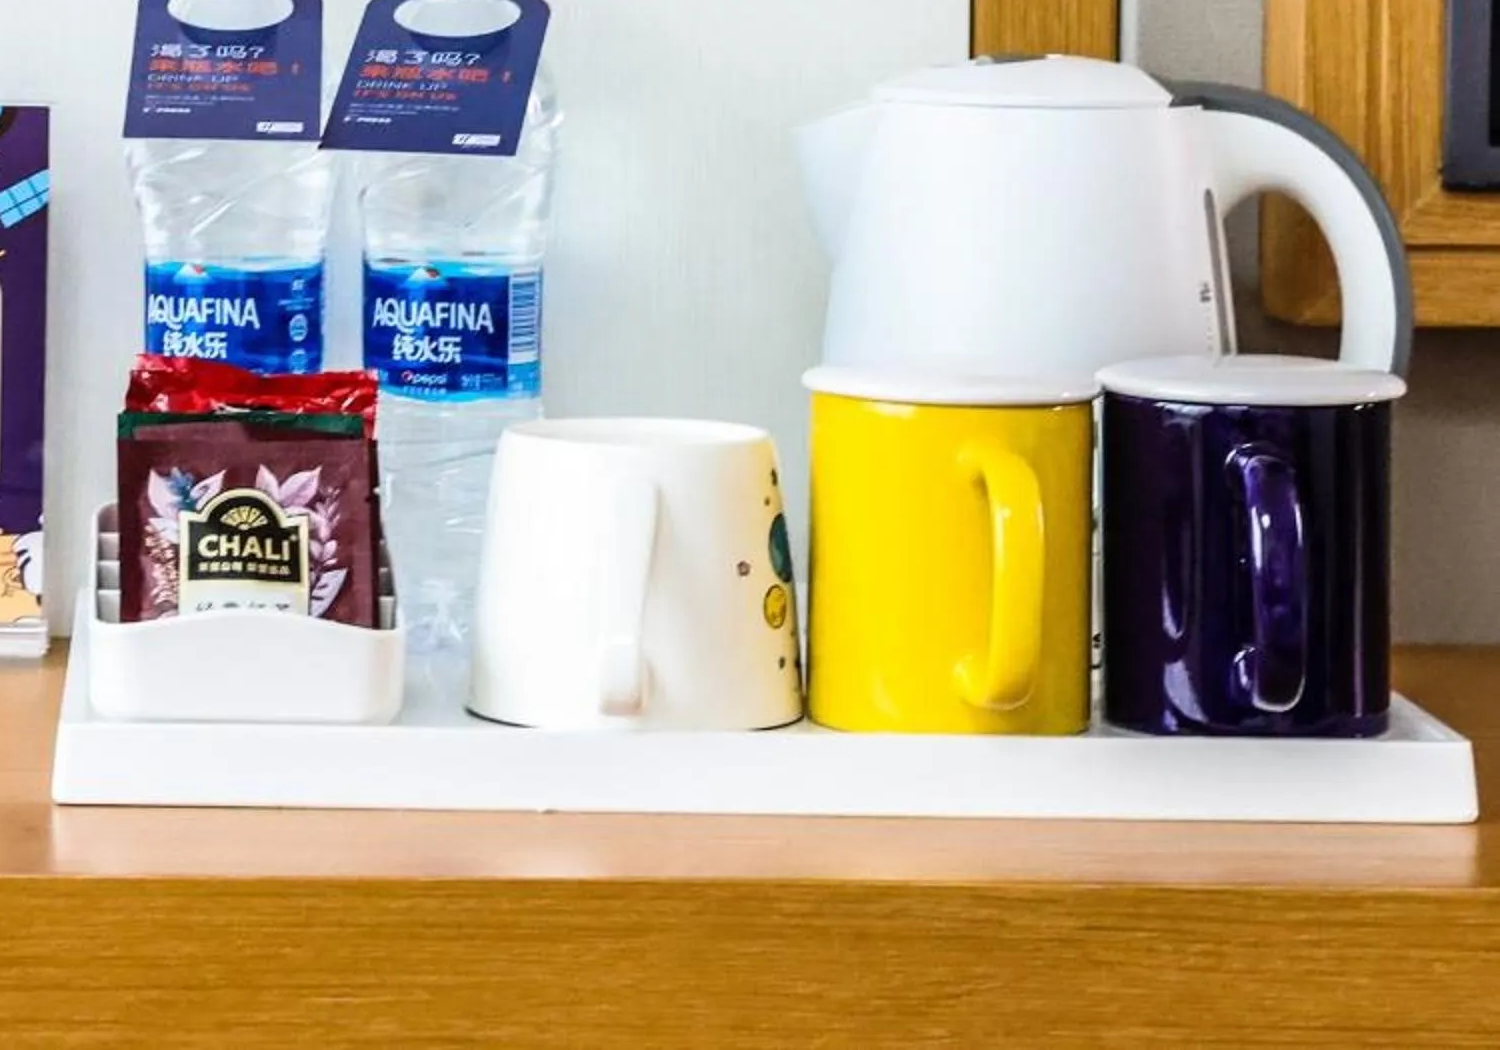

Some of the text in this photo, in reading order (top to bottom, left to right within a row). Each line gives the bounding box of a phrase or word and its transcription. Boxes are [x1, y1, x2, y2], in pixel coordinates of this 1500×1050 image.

[372, 297, 495, 334] AQUAFINA
[163, 330, 228, 359] 纯水乐
[392, 334, 462, 364] 纯水乐
[197, 534, 290, 561] CHALI
